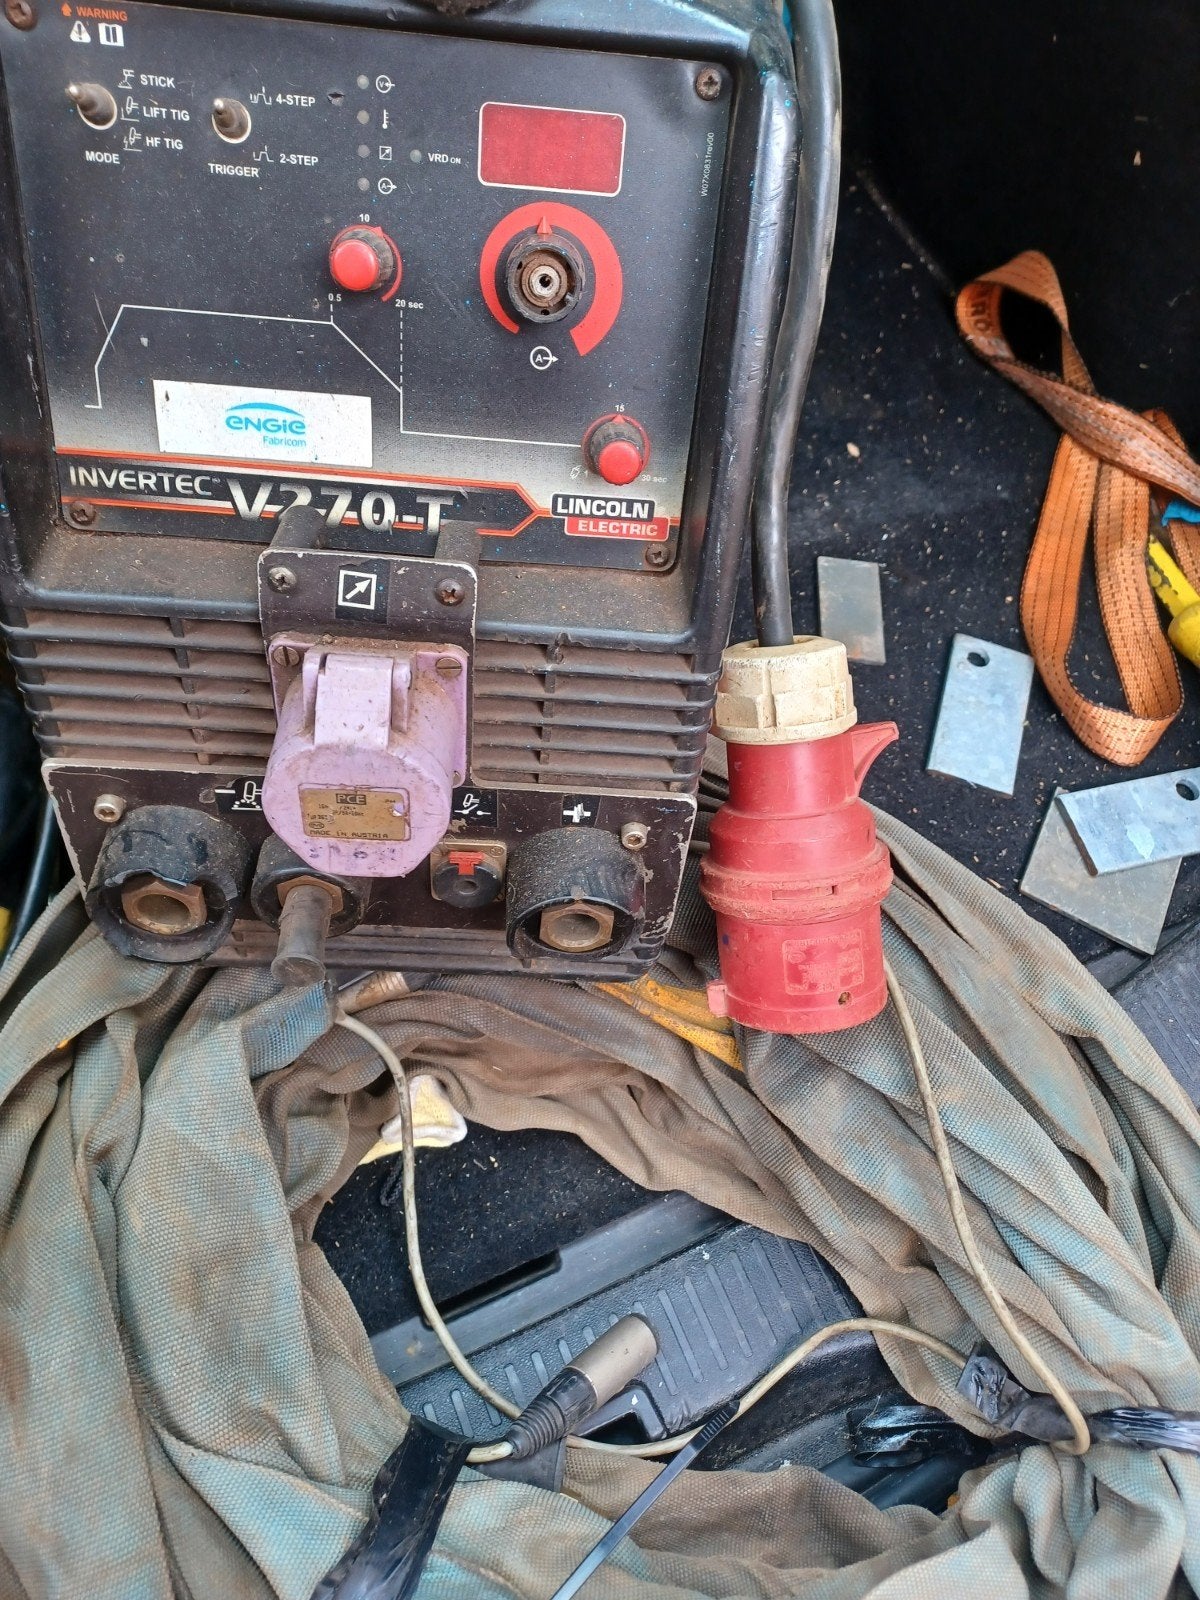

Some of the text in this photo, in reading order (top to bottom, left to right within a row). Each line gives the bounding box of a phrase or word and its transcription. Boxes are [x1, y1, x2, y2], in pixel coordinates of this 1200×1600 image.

[76, 6, 128, 21] WARNING
[140, 74, 175, 88] STICK
[275, 94, 316, 106] 4-STEP
[143, 106, 190, 120] LIFT TIG
[145, 136, 183, 149] HF TIG
[85, 150, 120, 164] MODE
[279, 155, 318, 166] 2-STEP
[428, 153, 449, 163] VRD
[208, 163, 259, 177] TRIGGER
[359, 213, 370, 222] 10
[395, 299, 424, 309] 20 sec
[615, 404, 624, 412] 15
[262, 436, 307, 447] Fabricom
[641, 474, 651, 482] 30
[557, 497, 649, 519] LINCOLN
[578, 519, 658, 536] ELECTRIC
[337, 794, 366, 804] PCE
